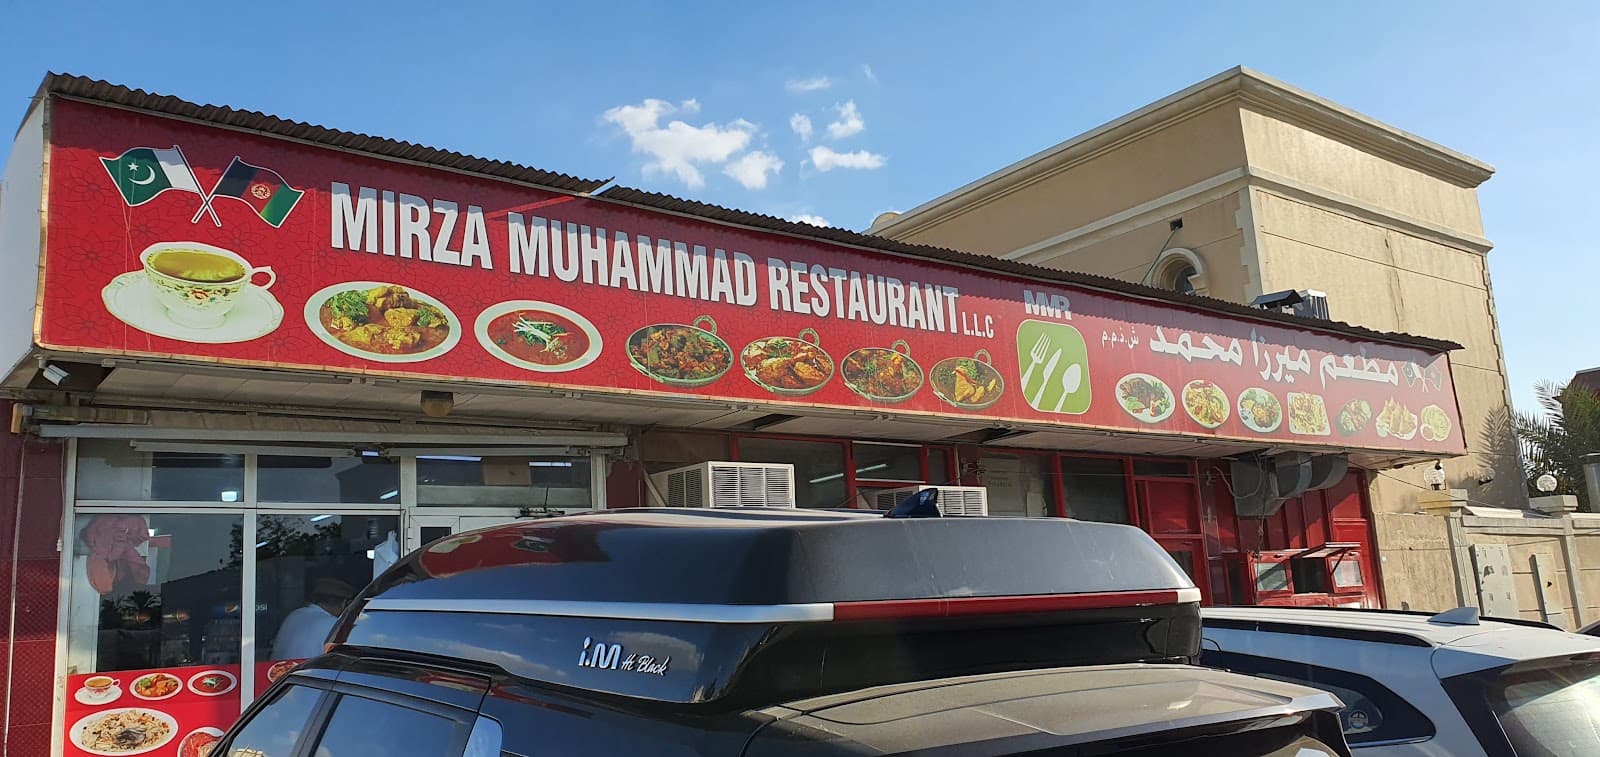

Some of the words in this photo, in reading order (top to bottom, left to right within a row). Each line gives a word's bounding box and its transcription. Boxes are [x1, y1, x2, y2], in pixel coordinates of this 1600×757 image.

[331, 181, 493, 270] MIRZA
[508, 212, 757, 307] MUHAMMAD
[767, 257, 959, 334] RESTAURANT
[962, 311, 994, 339] L.L.C
[1023, 289, 1072, 320] MMR
[1149, 325, 1243, 367] محمد
[1250, 327, 1311, 384] ميرزا
[1319, 343, 1399, 390] مطعم
[636, 655, 670, 676] Black
